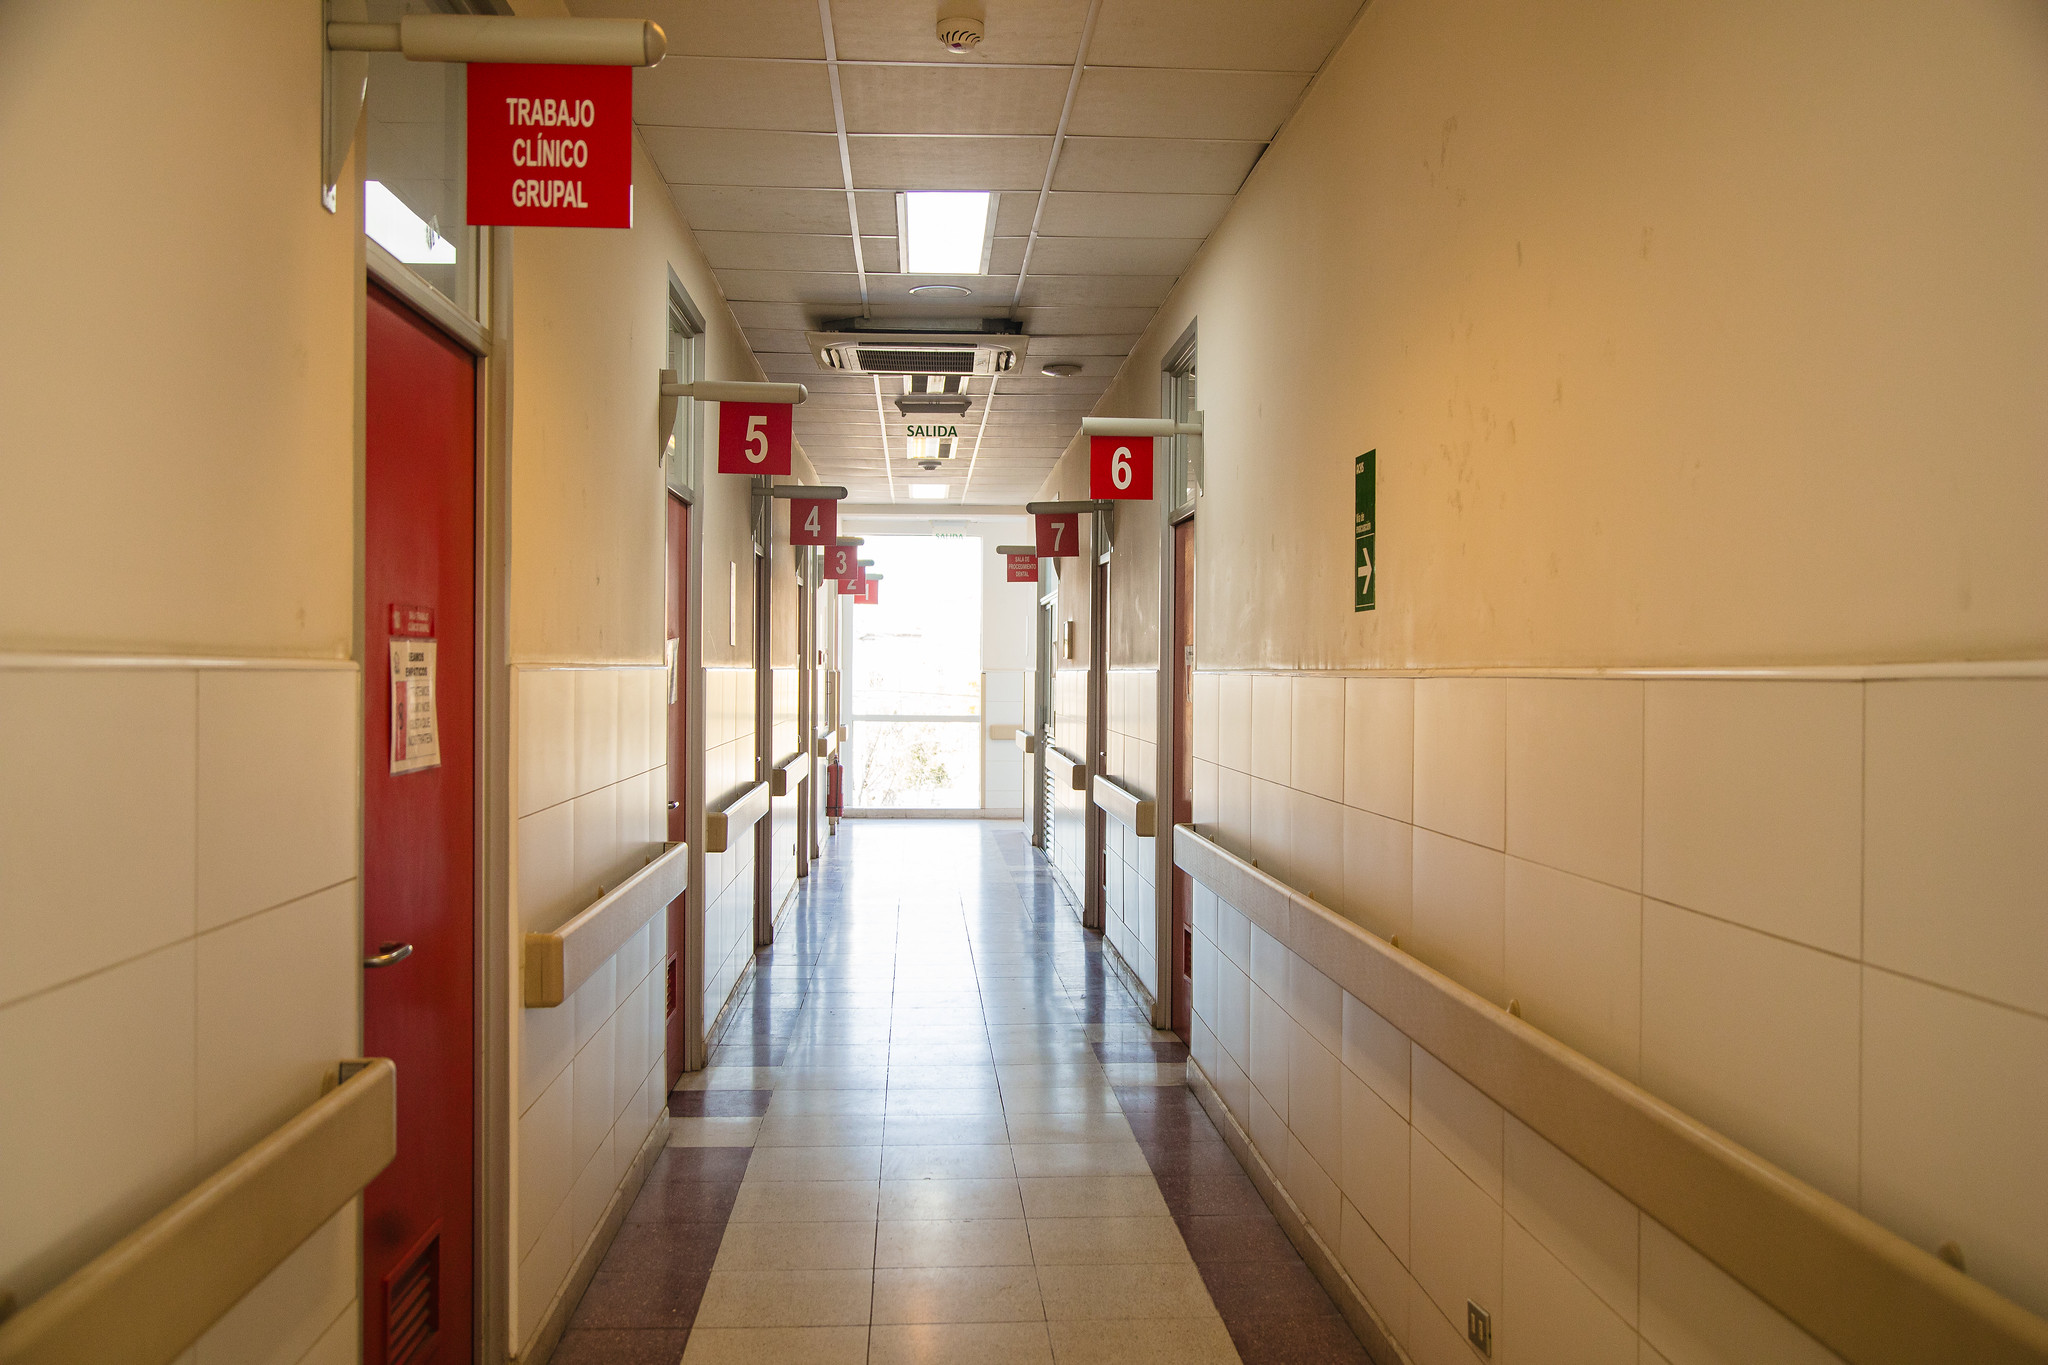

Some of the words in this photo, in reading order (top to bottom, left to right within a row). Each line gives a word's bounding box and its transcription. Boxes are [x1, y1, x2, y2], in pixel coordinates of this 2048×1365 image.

[506, 97, 595, 128] TRABAJO
[512, 132, 588, 168] CLÍNICO
[512, 178, 588, 208] GRUPAL
[744, 415, 769, 464] 5
[906, 424, 958, 437] SALIDA
[1111, 446, 1132, 490] 6
[804, 505, 821, 537] 4
[1051, 522, 1065, 552] 7
[835, 550, 847, 575] 3
